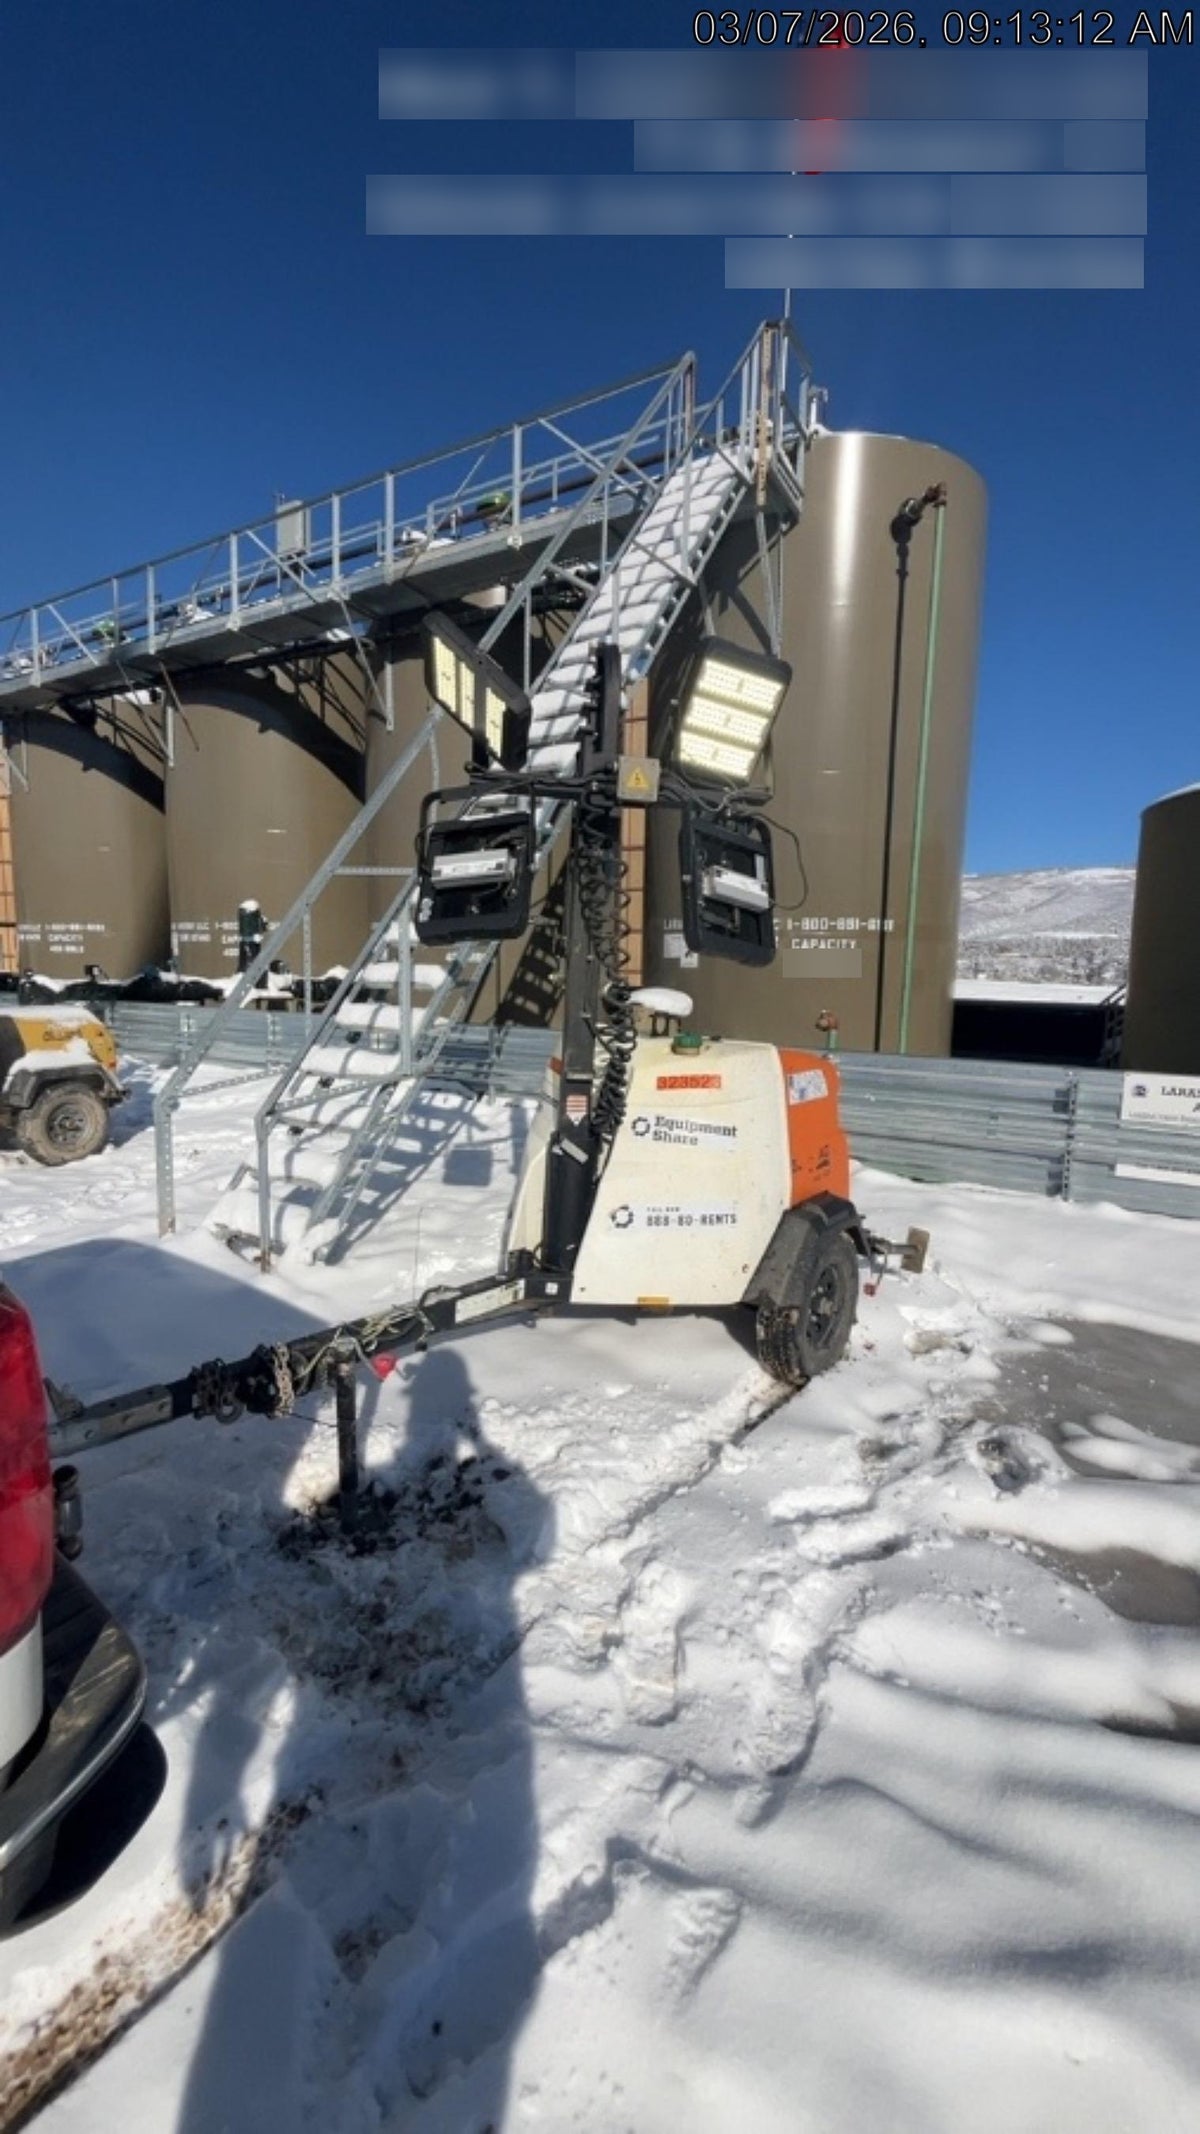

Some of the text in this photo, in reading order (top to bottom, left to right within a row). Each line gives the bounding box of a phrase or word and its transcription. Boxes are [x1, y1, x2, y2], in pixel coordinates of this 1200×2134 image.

[791, 938, 857, 949] CAPACITY
[654, 1115, 738, 1137] Equipment
[652, 1130, 698, 1145] Share
